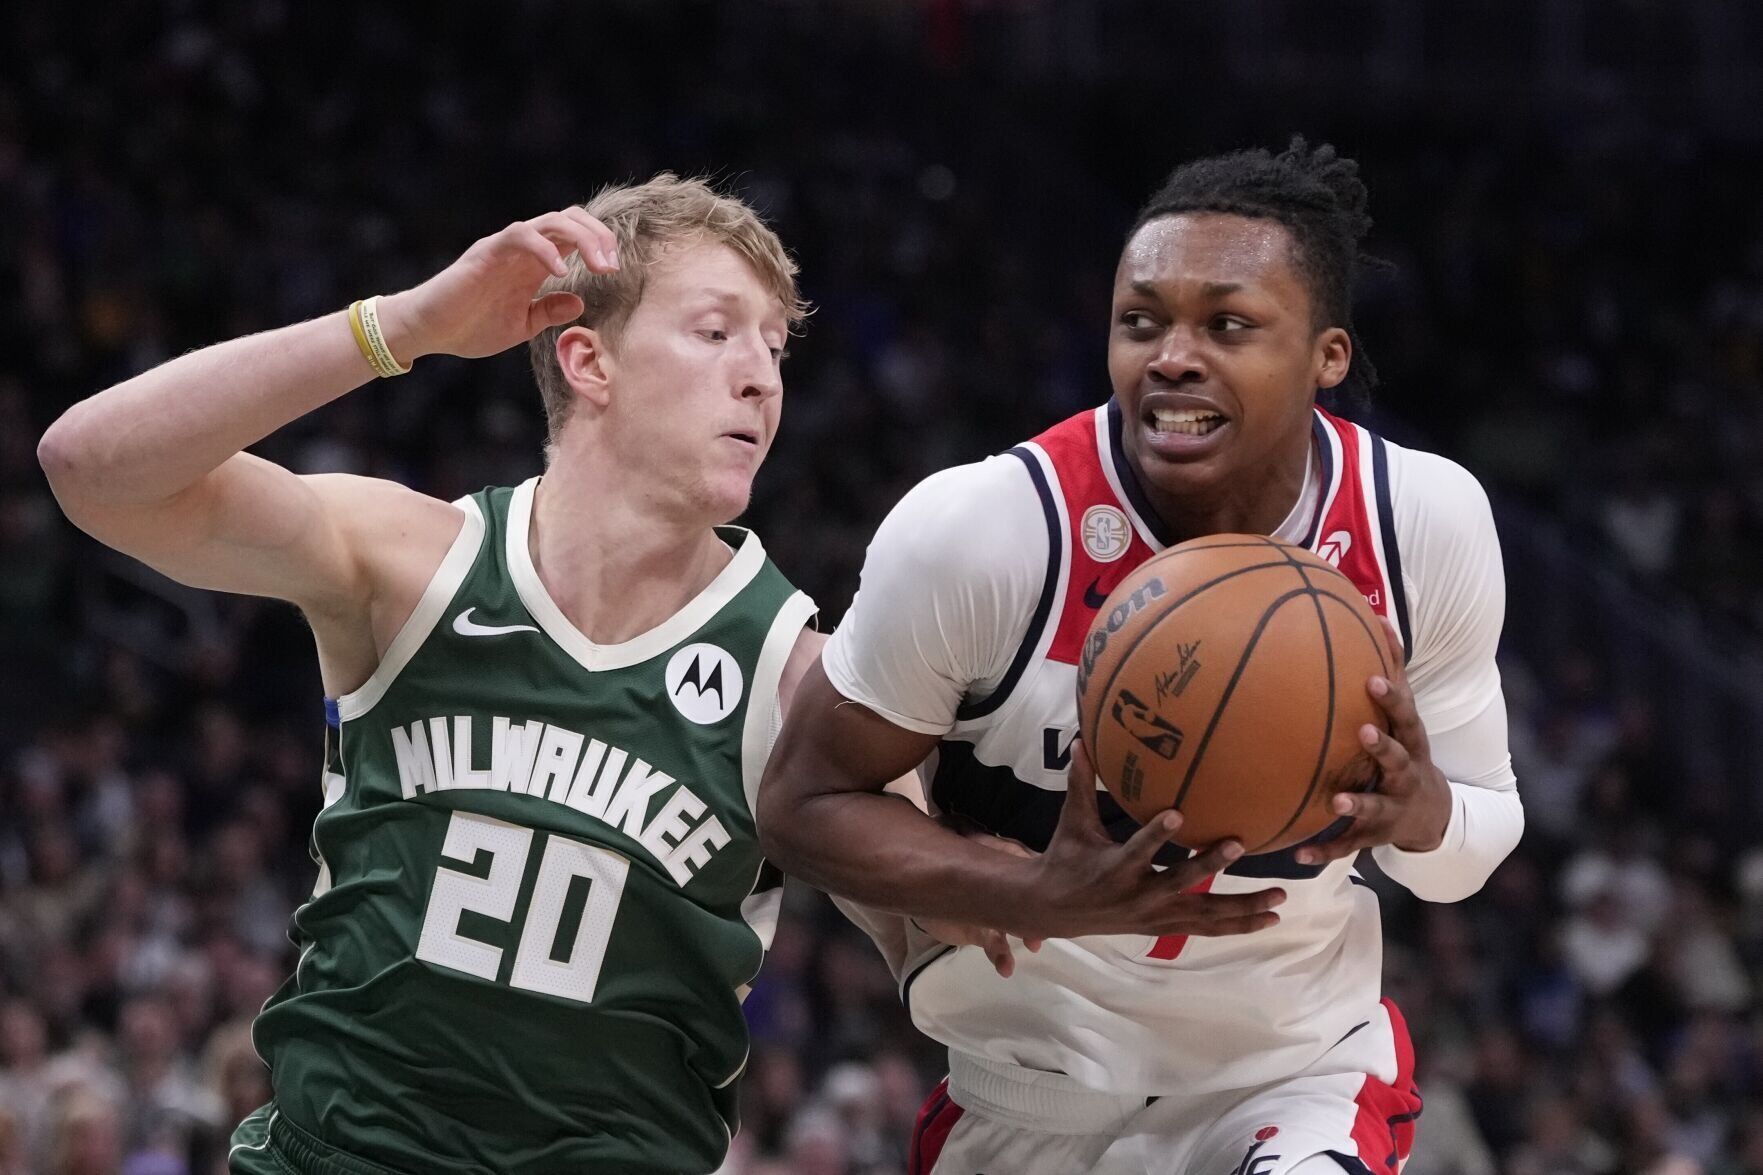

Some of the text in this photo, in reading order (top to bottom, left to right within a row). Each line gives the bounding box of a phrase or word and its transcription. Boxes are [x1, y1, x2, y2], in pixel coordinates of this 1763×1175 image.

[1077, 577, 1168, 697] lson
[390, 715, 732, 888] MILWAUKEE
[415, 809, 631, 1003] 20
